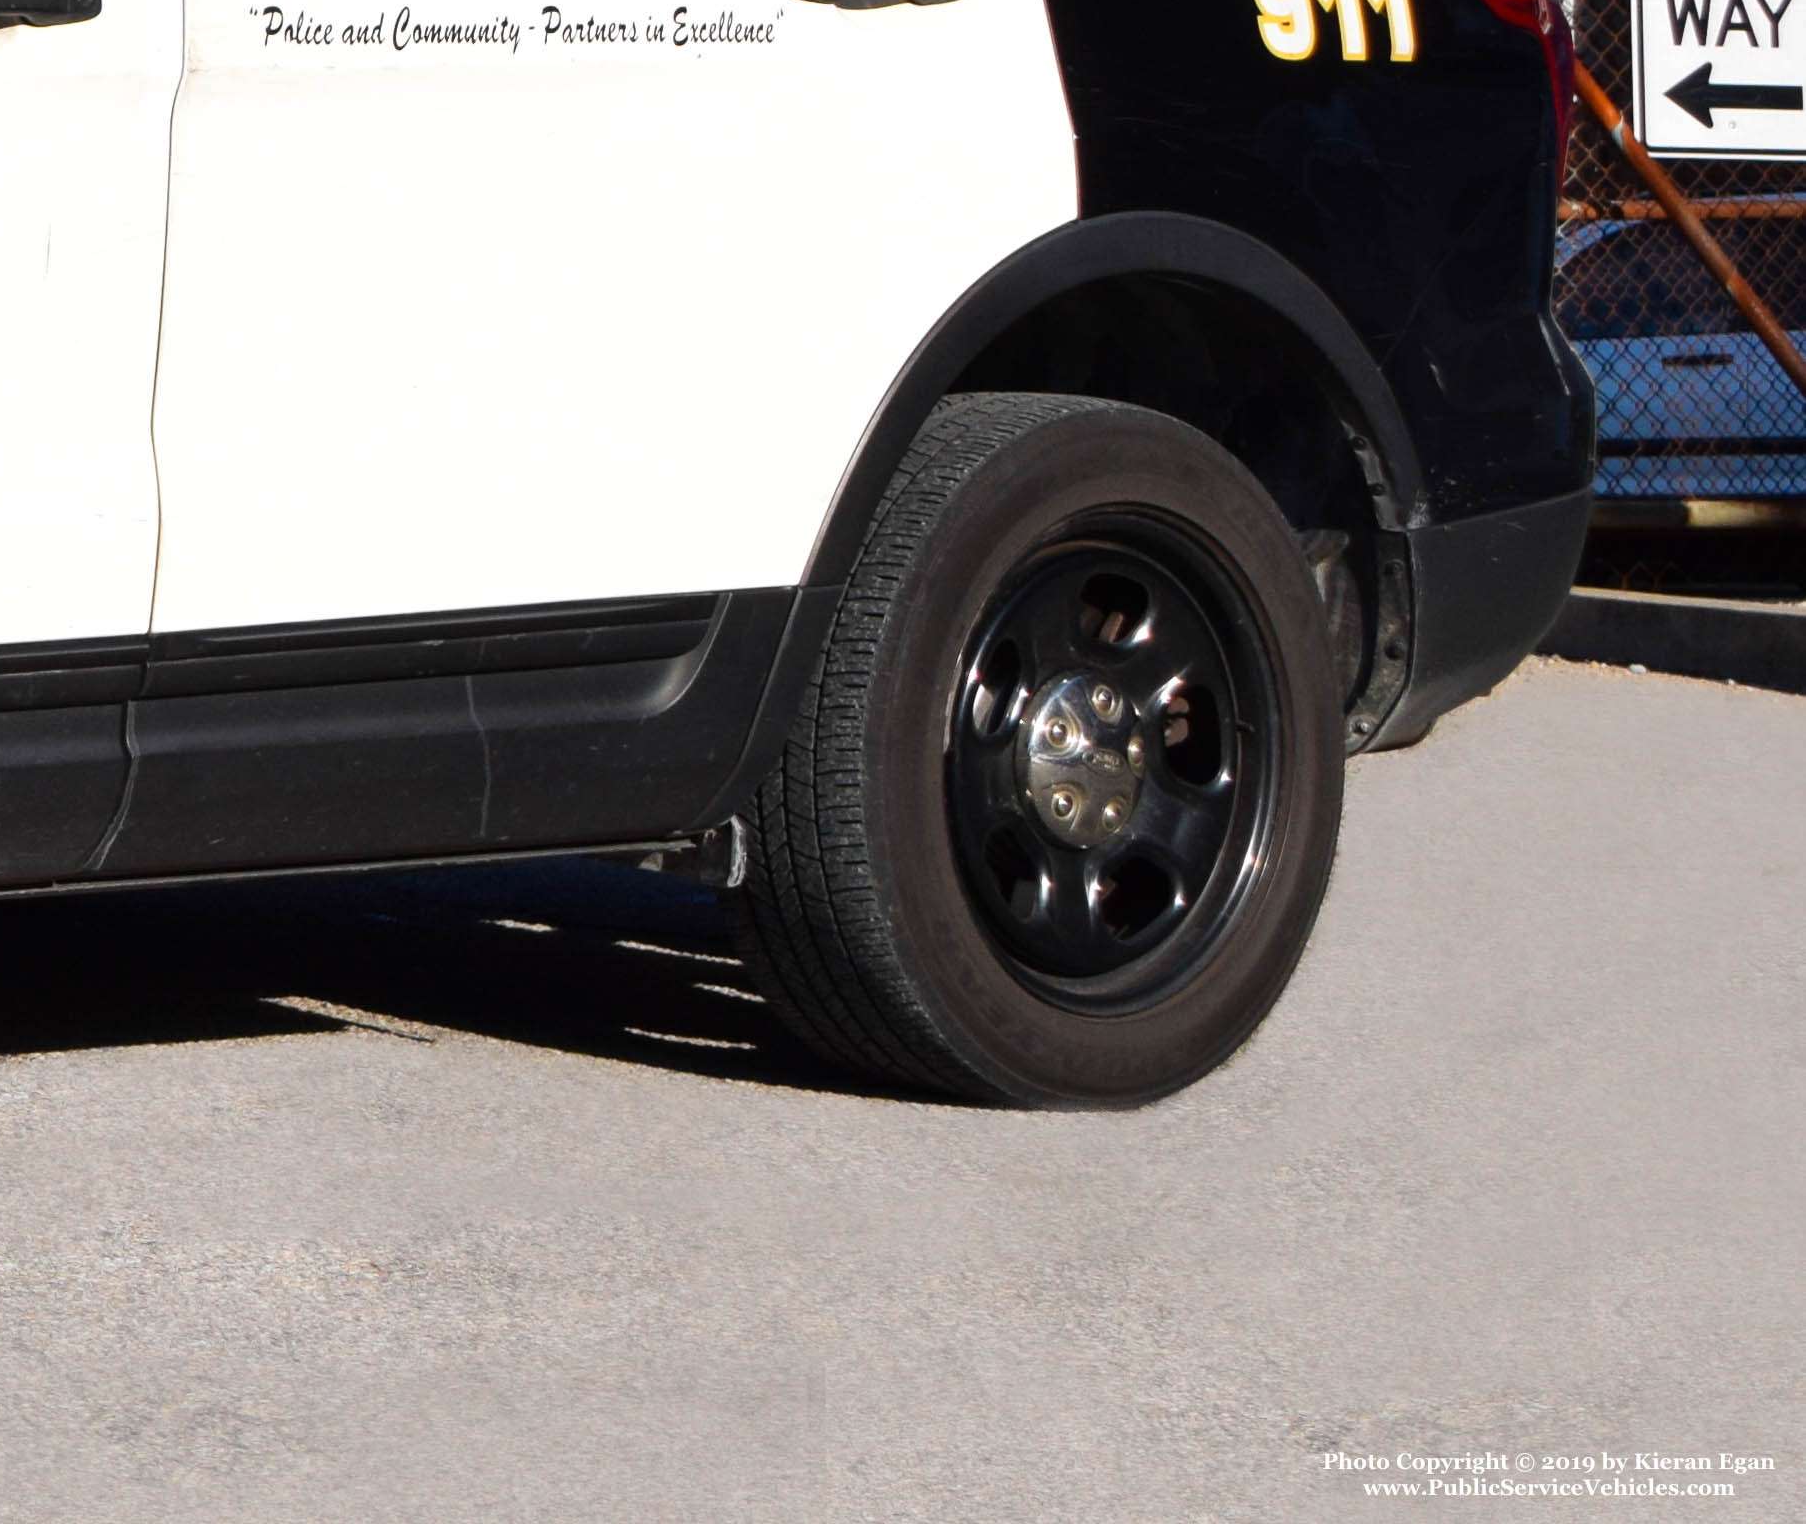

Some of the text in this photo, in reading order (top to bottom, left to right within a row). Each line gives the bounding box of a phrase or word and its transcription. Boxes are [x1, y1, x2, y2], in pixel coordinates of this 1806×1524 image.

[341, 12, 384, 46] and
[392, 6, 521, 53] Community
[542, 5, 639, 46] Partners
[645, 15, 666, 44] in
